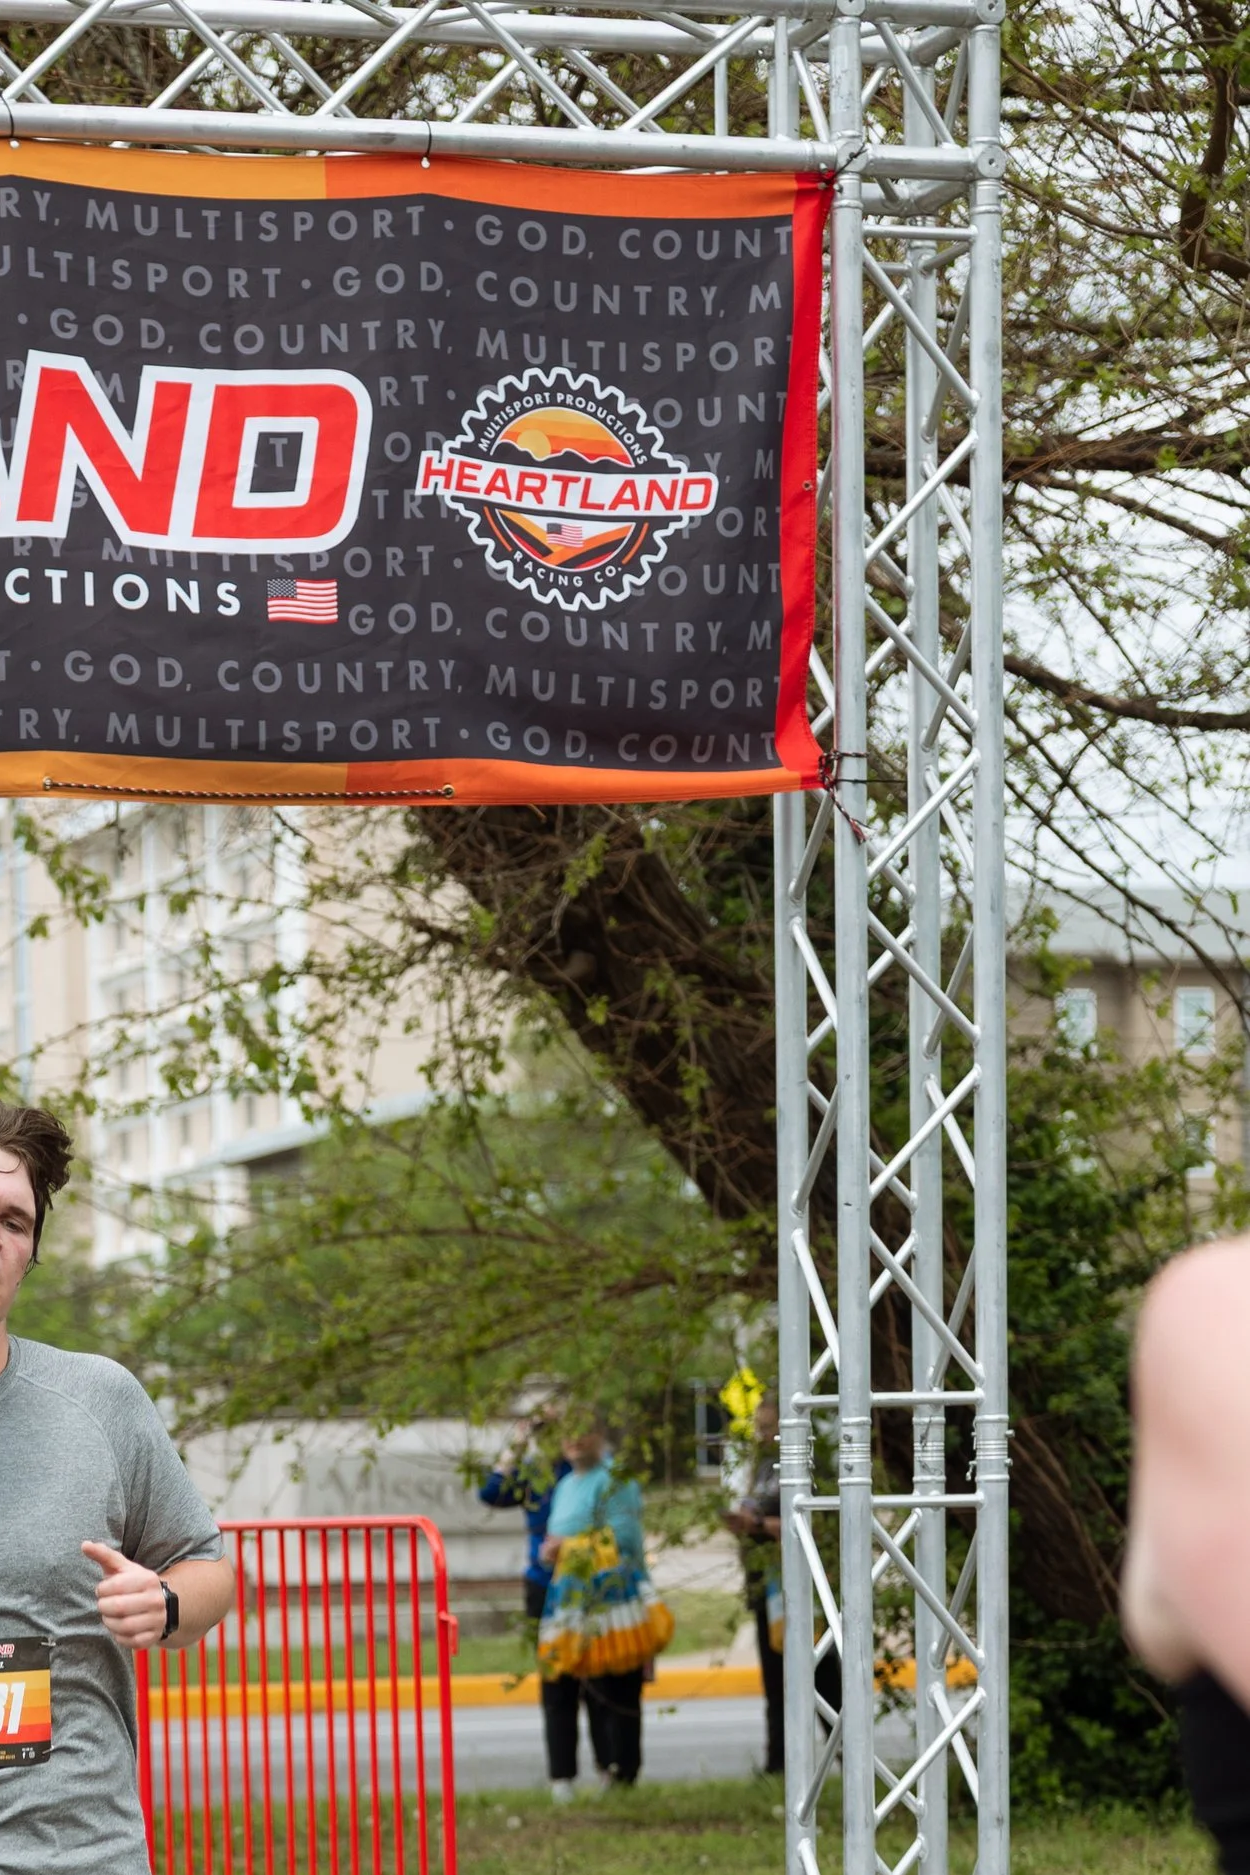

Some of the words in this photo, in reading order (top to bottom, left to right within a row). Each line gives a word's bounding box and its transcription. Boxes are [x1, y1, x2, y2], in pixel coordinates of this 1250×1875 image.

[85, 199, 425, 242] MULTISPORT
[476, 214, 594, 260] GOD,
[333, 262, 451, 297] GOD,
[476, 271, 725, 318] COUNTRY,
[50, 308, 174, 354] GOD,
[199, 319, 453, 355] COUNTRY,
[476, 328, 792, 372] MULTISPOR
[478, 391, 550, 452] MULTISPORT
[556, 392, 648, 466] PRODUCTIONS
[422, 455, 713, 512] HEARTLAND
[513, 550, 583, 587] RACING
[594, 566, 622, 583] CO.
[348, 602, 462, 635] GOD,
[485, 607, 727, 654] COUNTRY,
[64, 650, 192, 692] GOD,
[217, 659, 463, 694] COUNTRY,
[485, 664, 780, 710] MULTISPOR
[106, 712, 441, 751] MULTISPORT
[486, 722, 595, 763] GOD,
